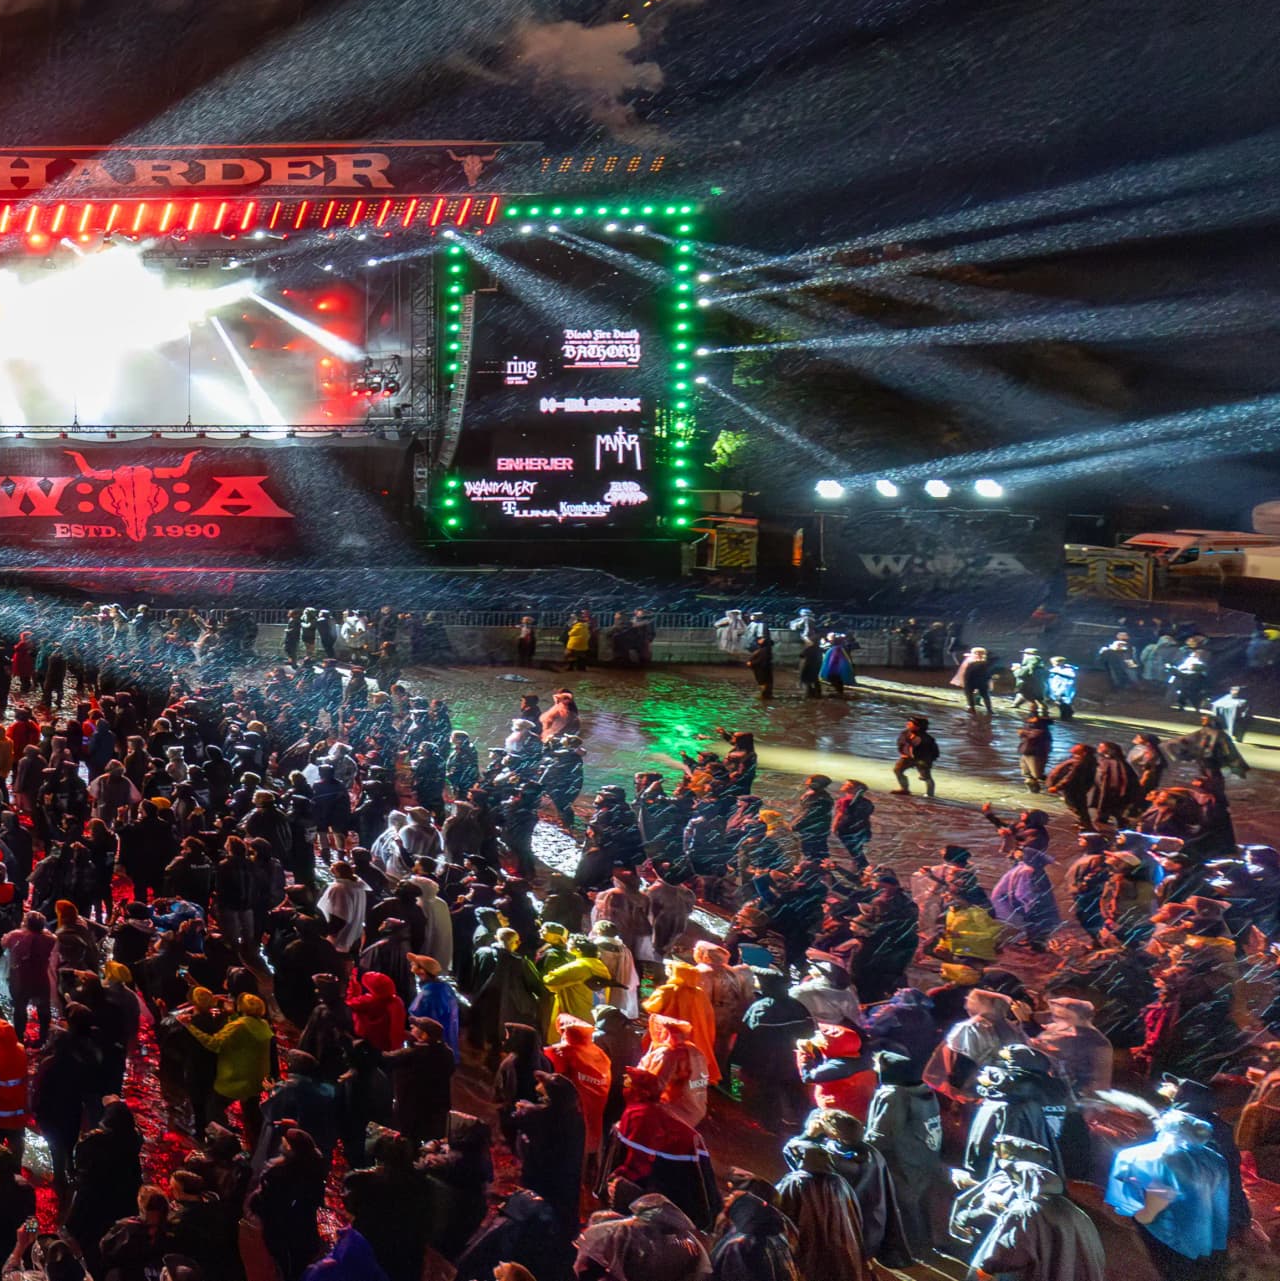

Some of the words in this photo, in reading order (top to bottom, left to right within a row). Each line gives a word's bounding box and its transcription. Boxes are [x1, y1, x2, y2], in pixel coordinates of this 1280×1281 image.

[497, 458, 574, 471] EINHERJER
[560, 502, 610, 513] Krombacher
[54, 523, 122, 538] ESTD.
[152, 523, 220, 538] 1990
